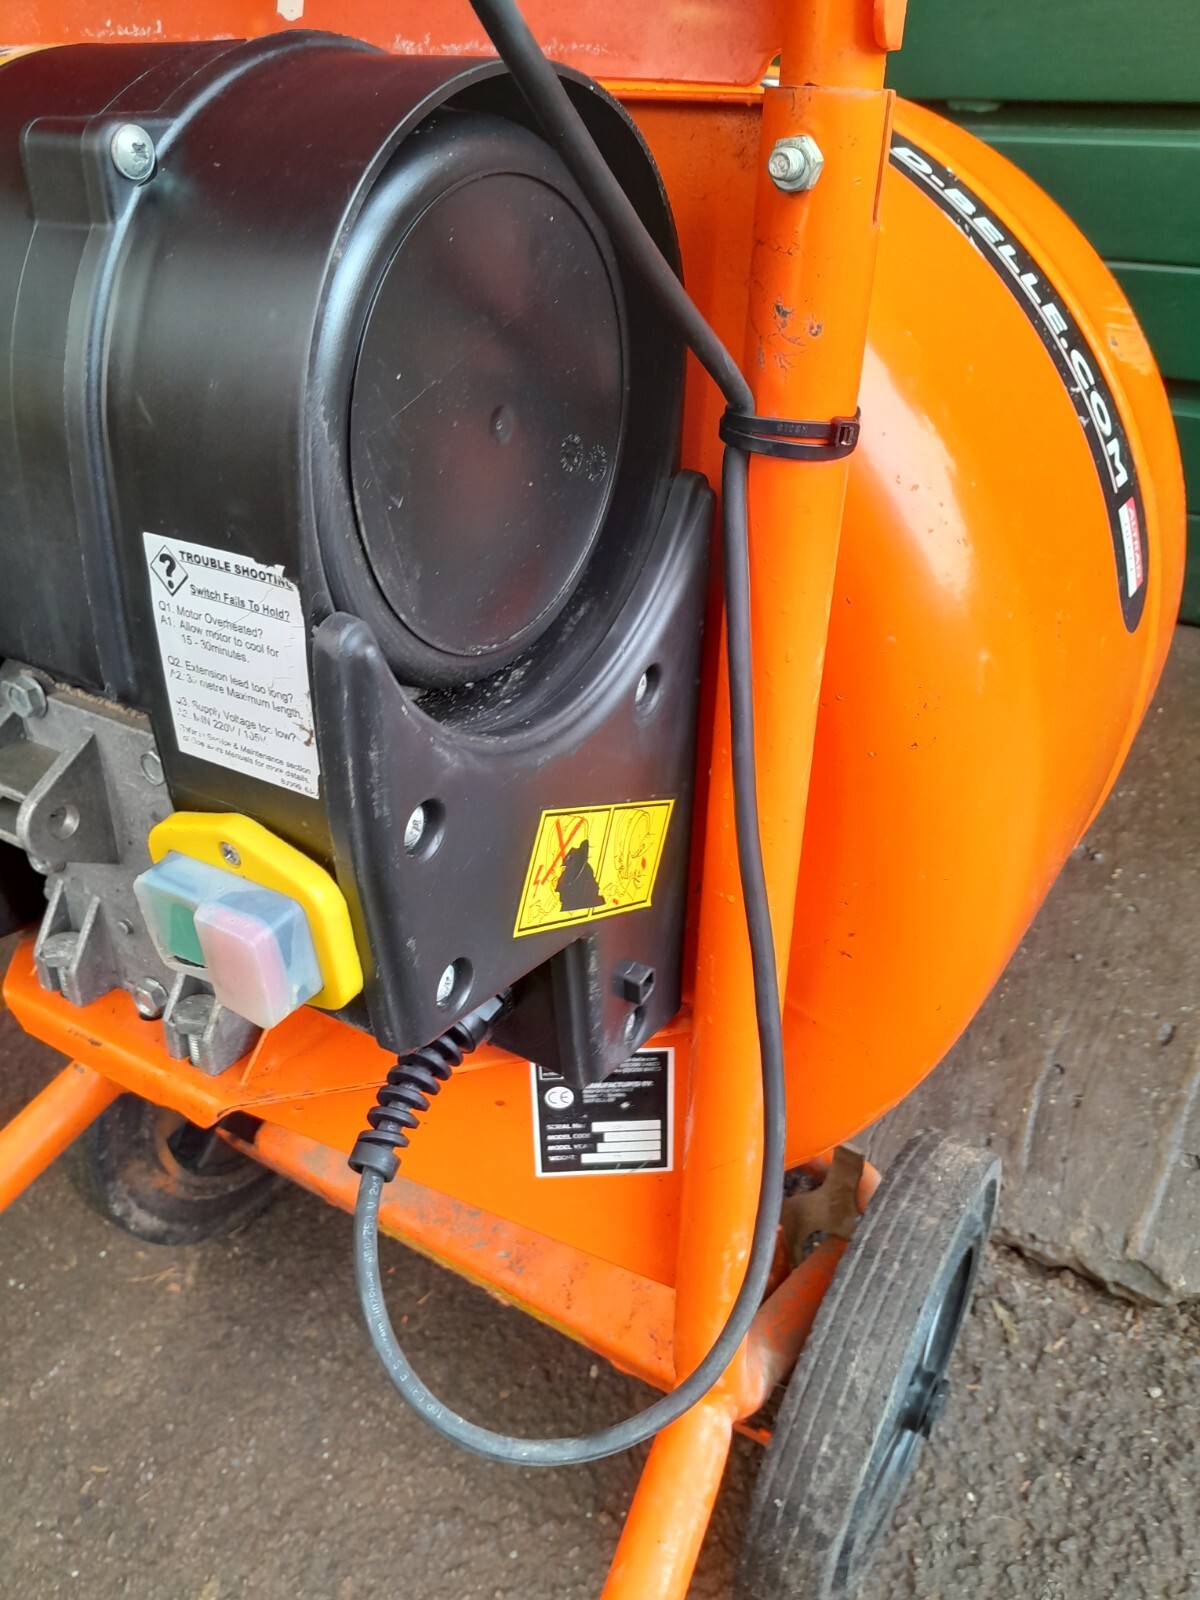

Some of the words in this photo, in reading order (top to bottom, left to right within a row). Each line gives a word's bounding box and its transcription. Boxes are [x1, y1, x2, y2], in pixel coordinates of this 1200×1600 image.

[179, 550, 231, 572] TROUBLE
[158, 600, 175, 614] Q1.
[177, 605, 203, 620] Motor
[205, 612, 263, 638] Overheated?
[189, 584, 221, 601] Switch
[224, 592, 246, 608] Fails
[248, 599, 261, 612] To
[262, 603, 291, 621] Hold?
[160, 614, 176, 628] A1.
[179, 620, 203, 636] Allow
[205, 629, 232, 644] motor
[234, 635, 243, 648] to
[245, 641, 265, 654] cool
[266, 645, 280, 658] for
[181, 634, 192, 646] 15
[200, 639, 250, 663] 30minutes.
[185, 661, 228, 682] Extension
[230, 674, 249, 690] lead
[251, 682, 267, 695] too
[268, 687, 294, 704] long?
[200, 680, 225, 694] metre
[227, 686, 271, 709] Maximum
[191, 700, 221, 718] Supply
[223, 709, 257, 730] Voltage
